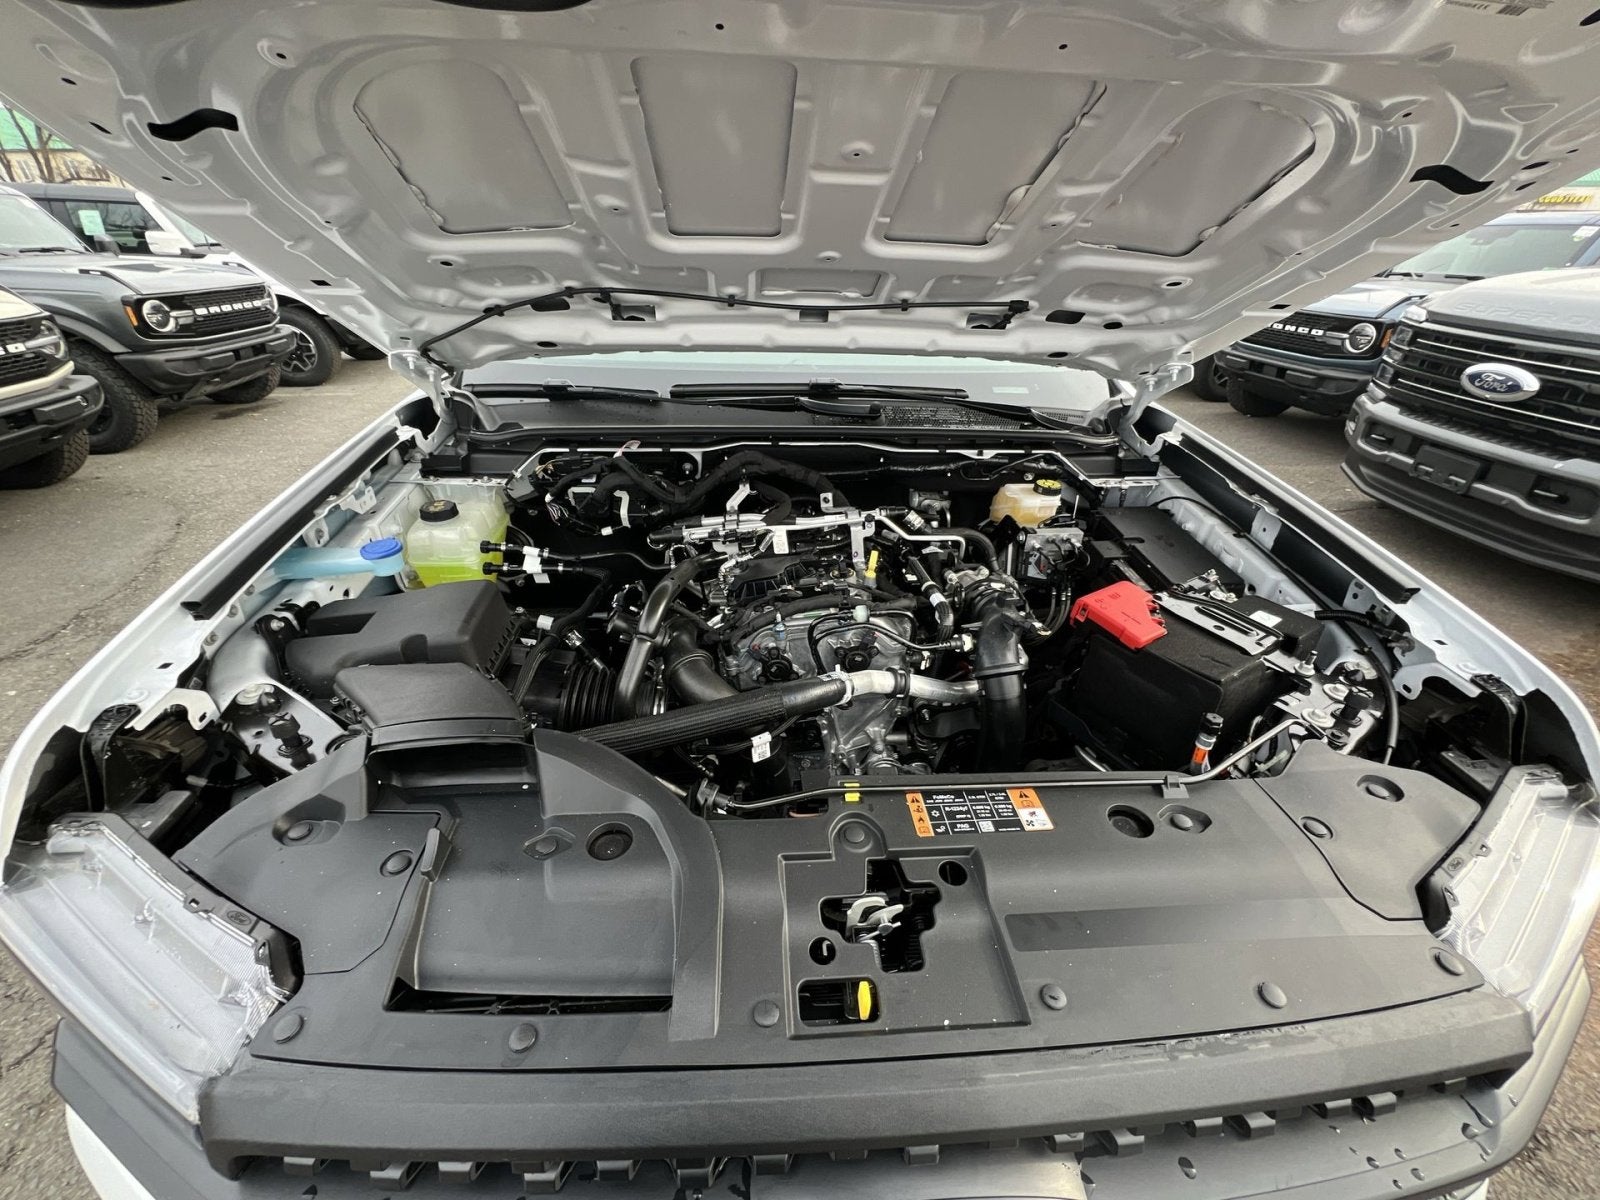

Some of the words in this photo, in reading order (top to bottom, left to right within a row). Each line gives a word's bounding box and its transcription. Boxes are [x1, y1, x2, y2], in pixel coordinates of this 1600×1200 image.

[194, 300, 262, 316] BRONCO
[1454, 302, 1558, 323] SUPER
[1269, 322, 1325, 336] ONCO
[1474, 372, 1513, 392] Ford
